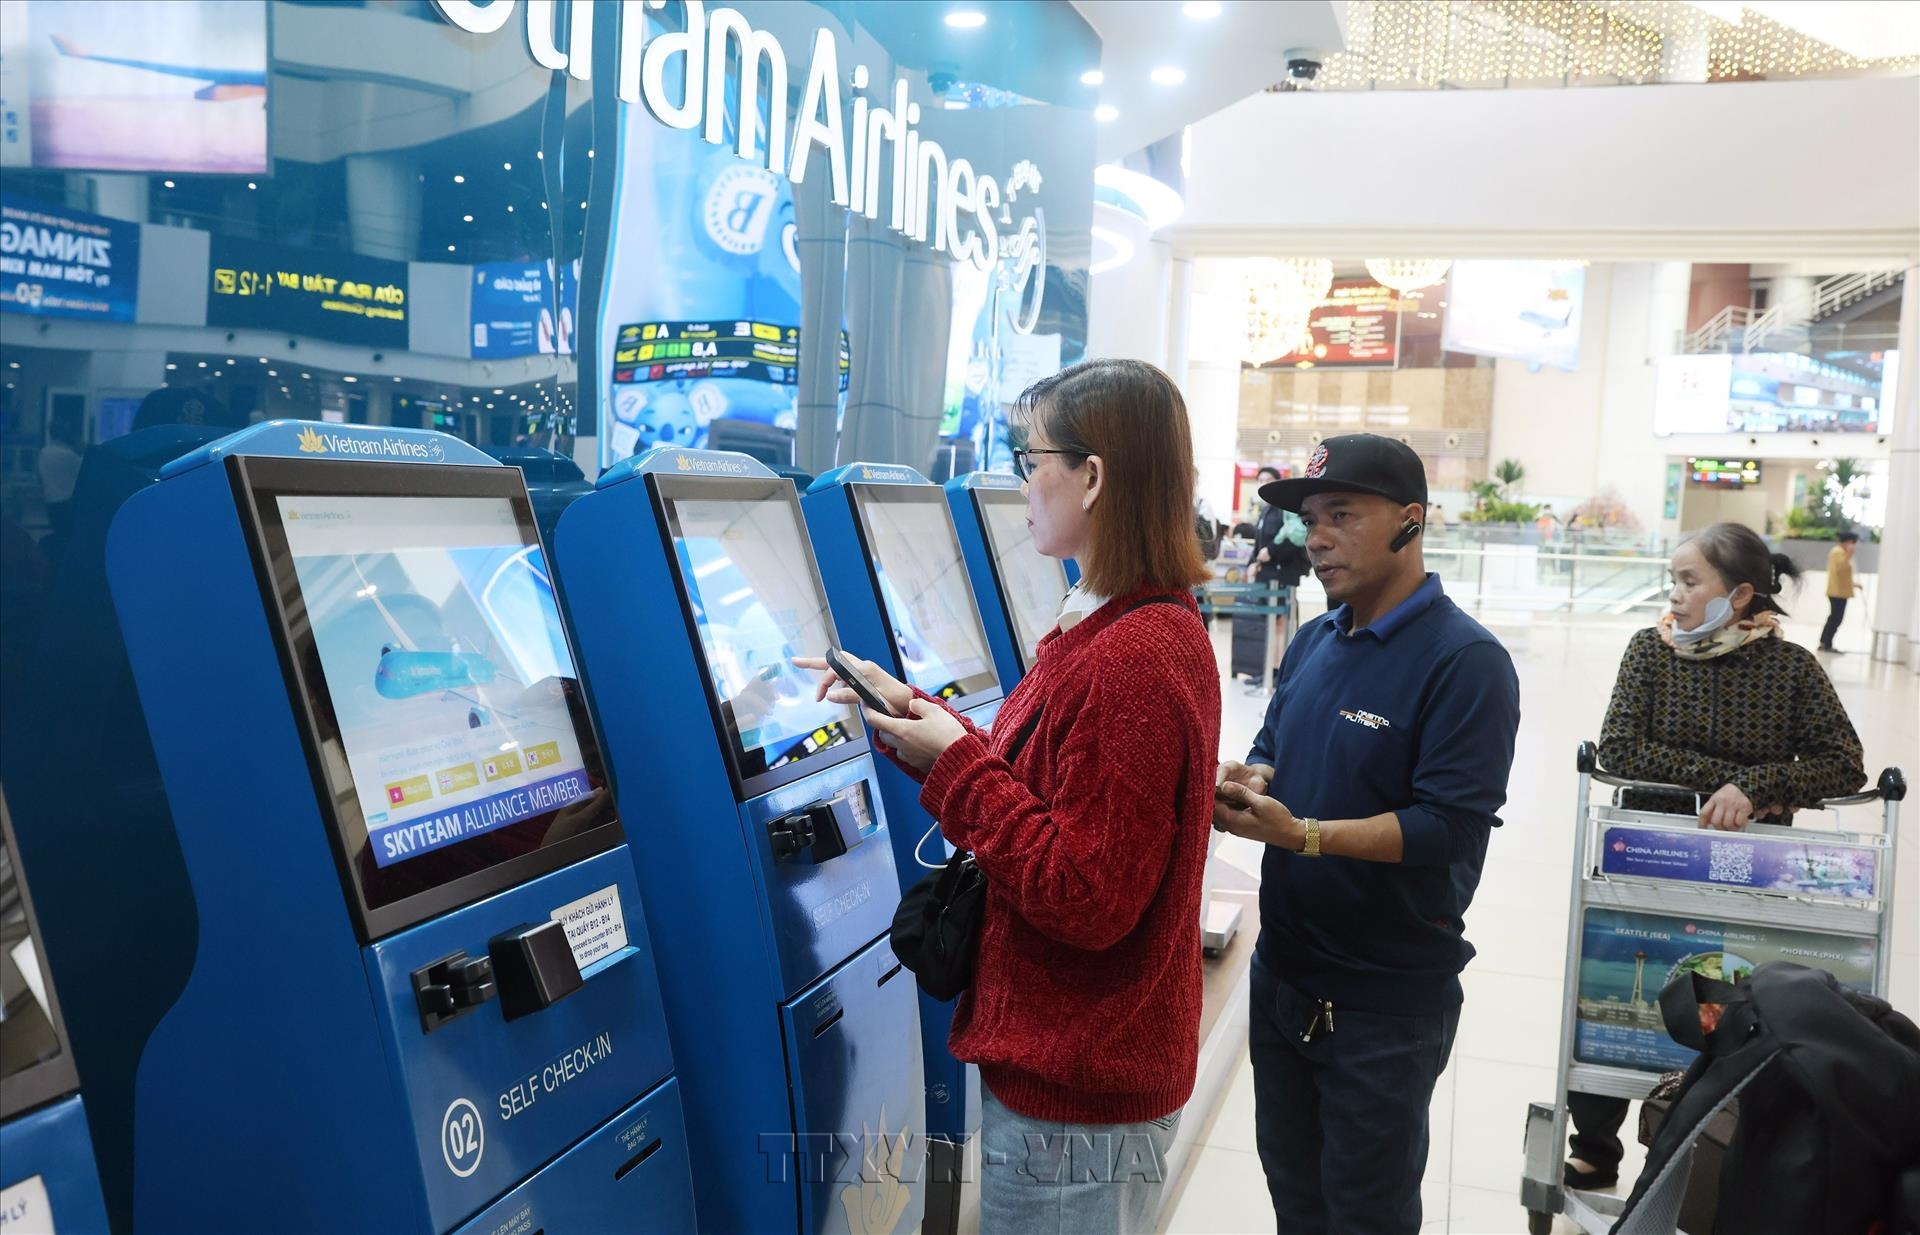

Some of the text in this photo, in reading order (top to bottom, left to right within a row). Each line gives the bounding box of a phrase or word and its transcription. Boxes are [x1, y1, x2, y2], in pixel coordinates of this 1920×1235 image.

[383, 776, 583, 859] SKYTEAM ALLIANCE MEMBER
[1625, 846, 1689, 858] CHINA AIRLINES
[1615, 927, 1649, 939] SEATTLE
[1780, 946, 1818, 959] PHOENIX
[499, 1032, 612, 1121] SELF CHECK-IN
[450, 1112, 478, 1160] 02
